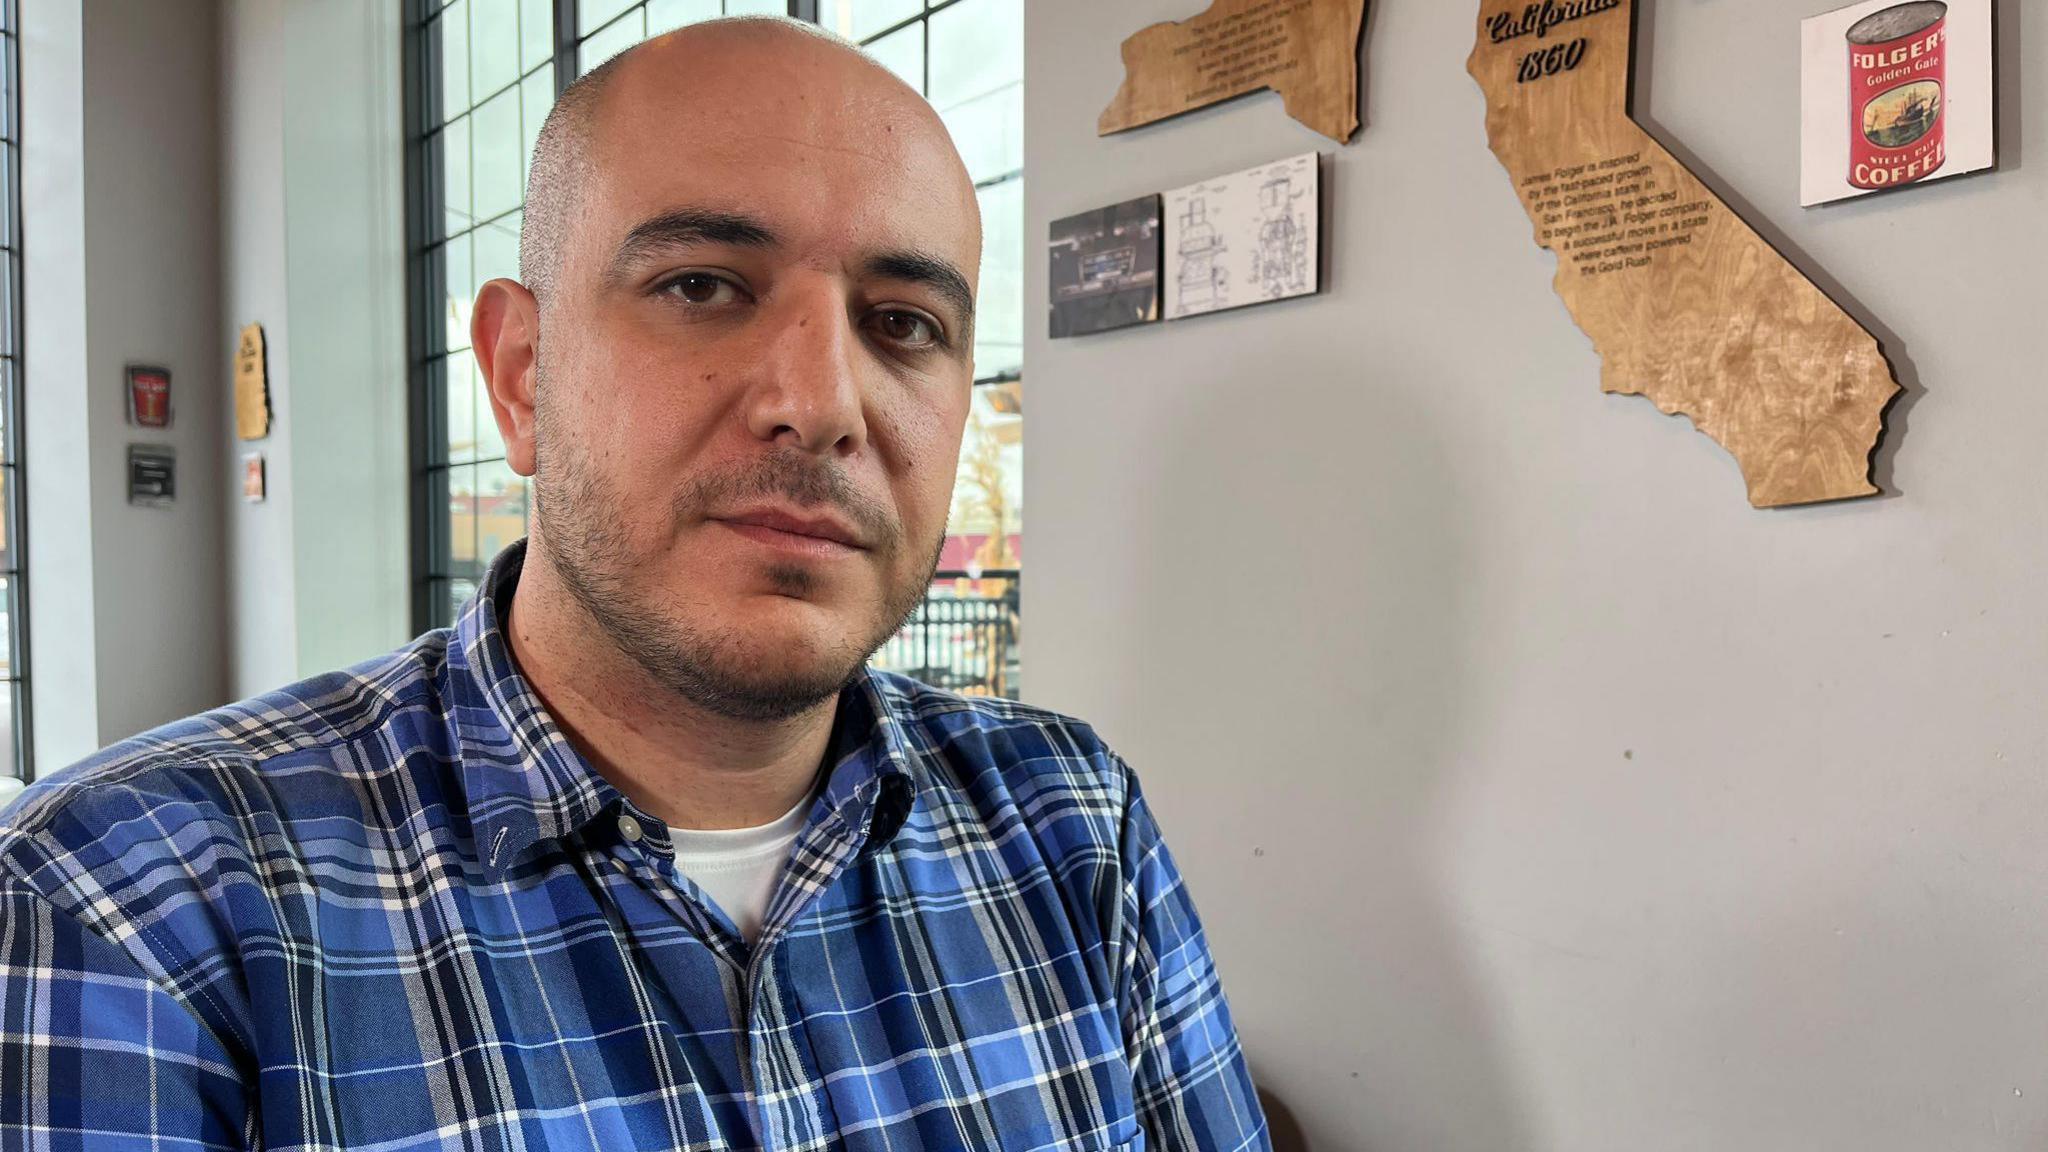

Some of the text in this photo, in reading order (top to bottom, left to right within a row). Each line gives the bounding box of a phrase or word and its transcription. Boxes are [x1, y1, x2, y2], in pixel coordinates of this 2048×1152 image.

[1485, 0, 1619, 44] California
[1517, 38, 1587, 83] 1860
[1866, 56, 1939, 87] Golden Gate
[1554, 164, 1585, 180] Folger
[1587, 163, 1596, 172] is
[1599, 152, 1640, 169] inspired
[1855, 142, 1946, 185] COFFEE
[1528, 165, 1652, 200] by the fast-paced growth
[1534, 201, 1544, 212] of
[1545, 199, 1561, 210] the
[1563, 190, 1611, 206] California
[1543, 213, 1562, 225] San
[1620, 199, 1633, 210] he
[1636, 190, 1677, 207] decided
[1542, 229, 1552, 239] to
[1554, 224, 1581, 238] begin
[1583, 221, 1599, 232] the
[1624, 210, 1656, 225] Folger
[1572, 231, 1625, 249] successful
[1627, 226, 1656, 238] move
[1658, 223, 1669, 233] in
[1671, 221, 1678, 231] a
[1681, 215, 1709, 229] state
[1572, 234, 1691, 263] where caffeine powered
[1580, 256, 1652, 276] the Gold Rush
